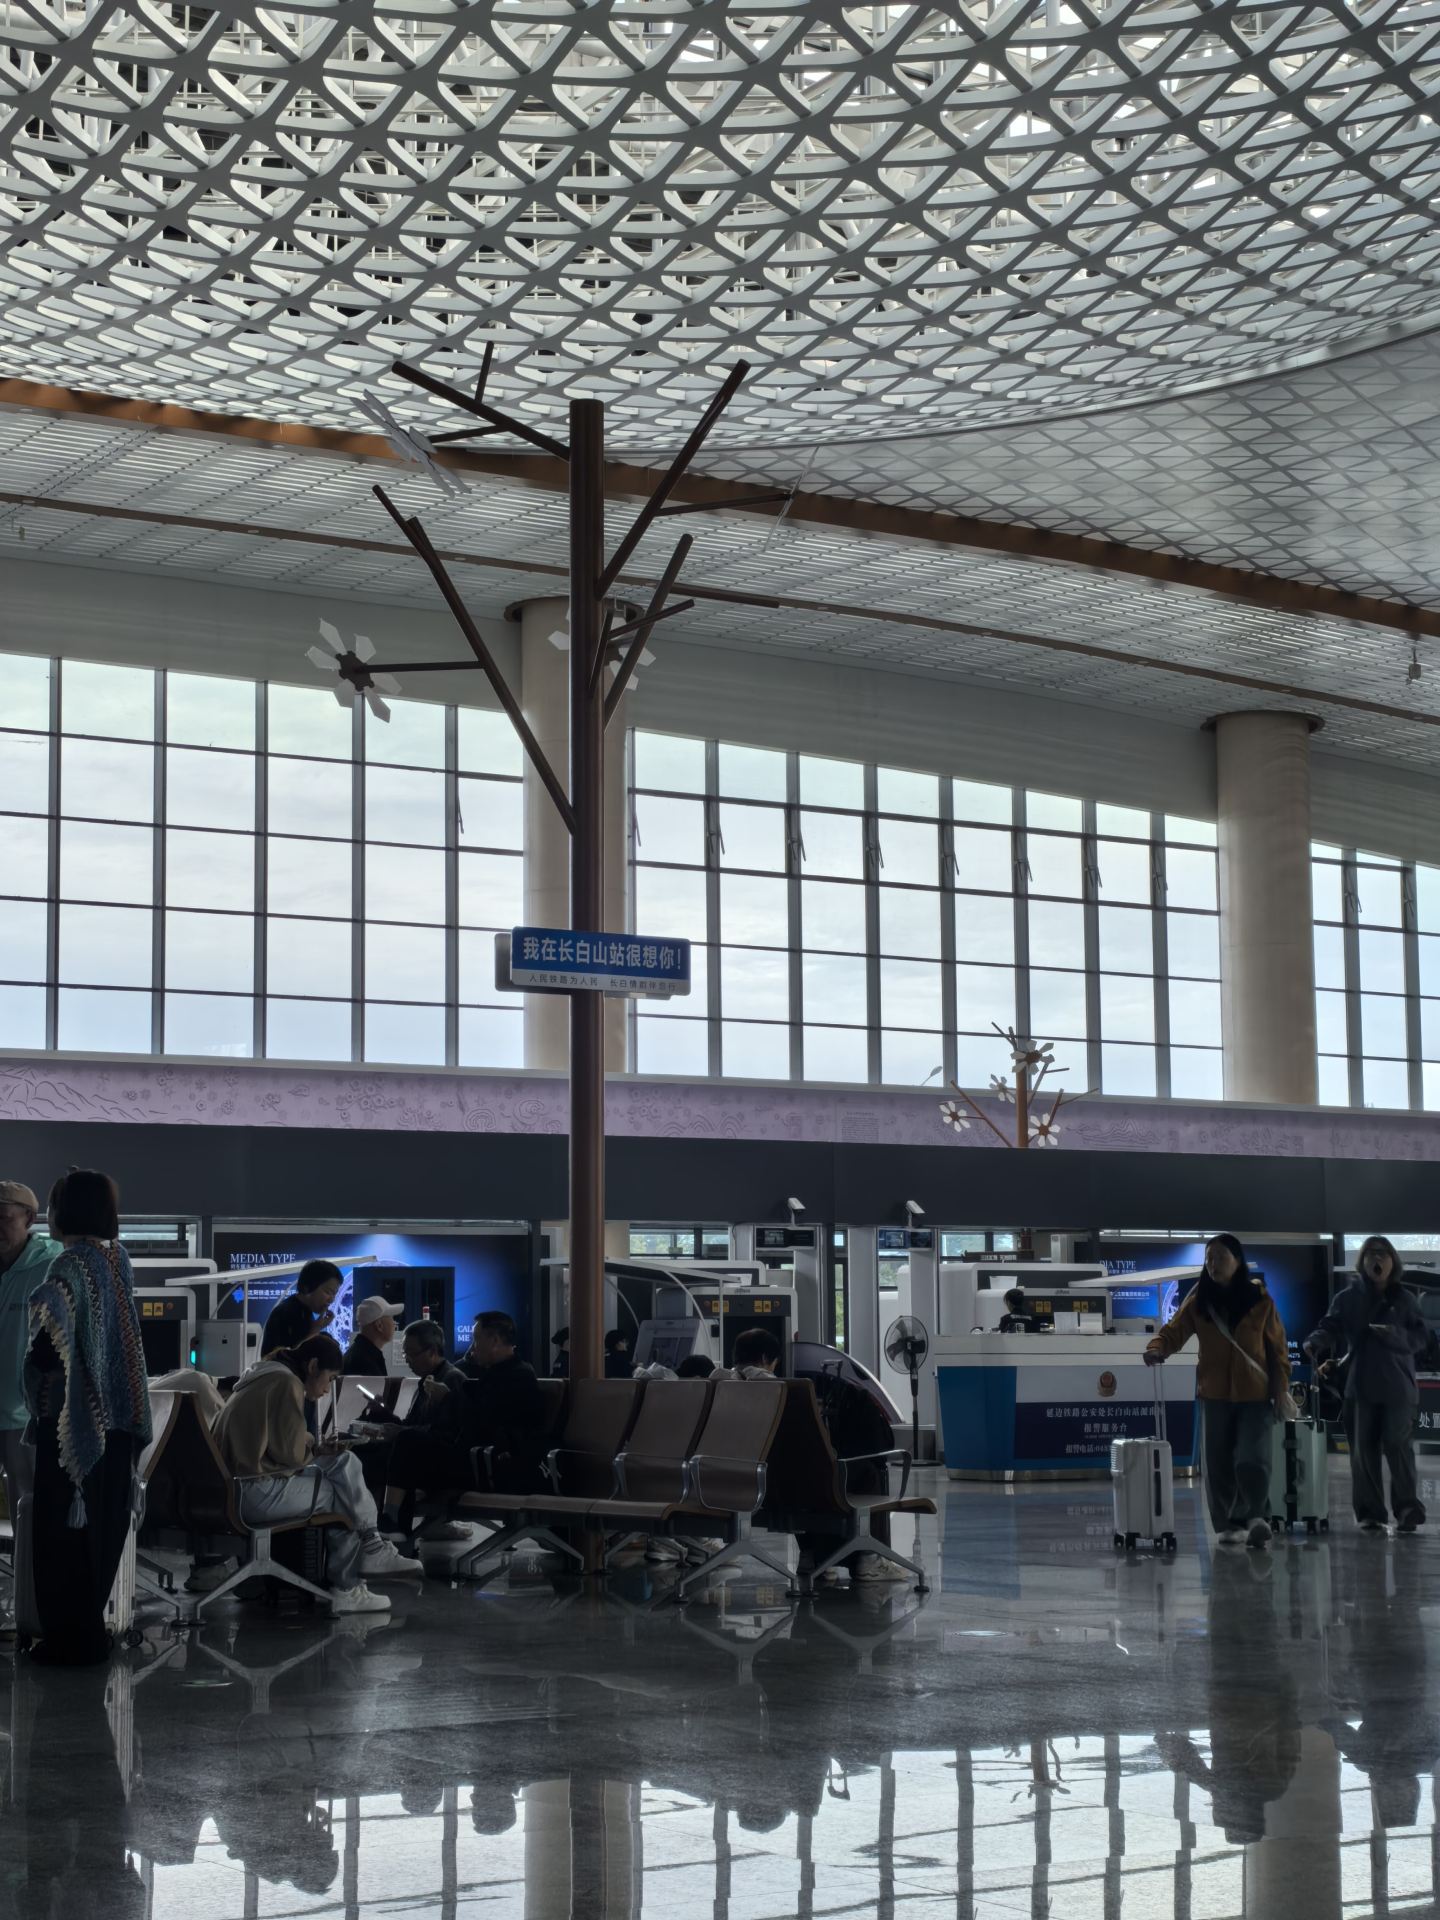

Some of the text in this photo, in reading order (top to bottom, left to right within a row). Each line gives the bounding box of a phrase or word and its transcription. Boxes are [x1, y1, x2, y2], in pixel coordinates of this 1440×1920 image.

[523, 936, 681, 969] 我在长白山站很想你!
[230, 1253, 296, 1264] MEDIA TYPE
[1116, 1260, 1137, 1269] TYPE
[457, 1325, 474, 1333] CAL
